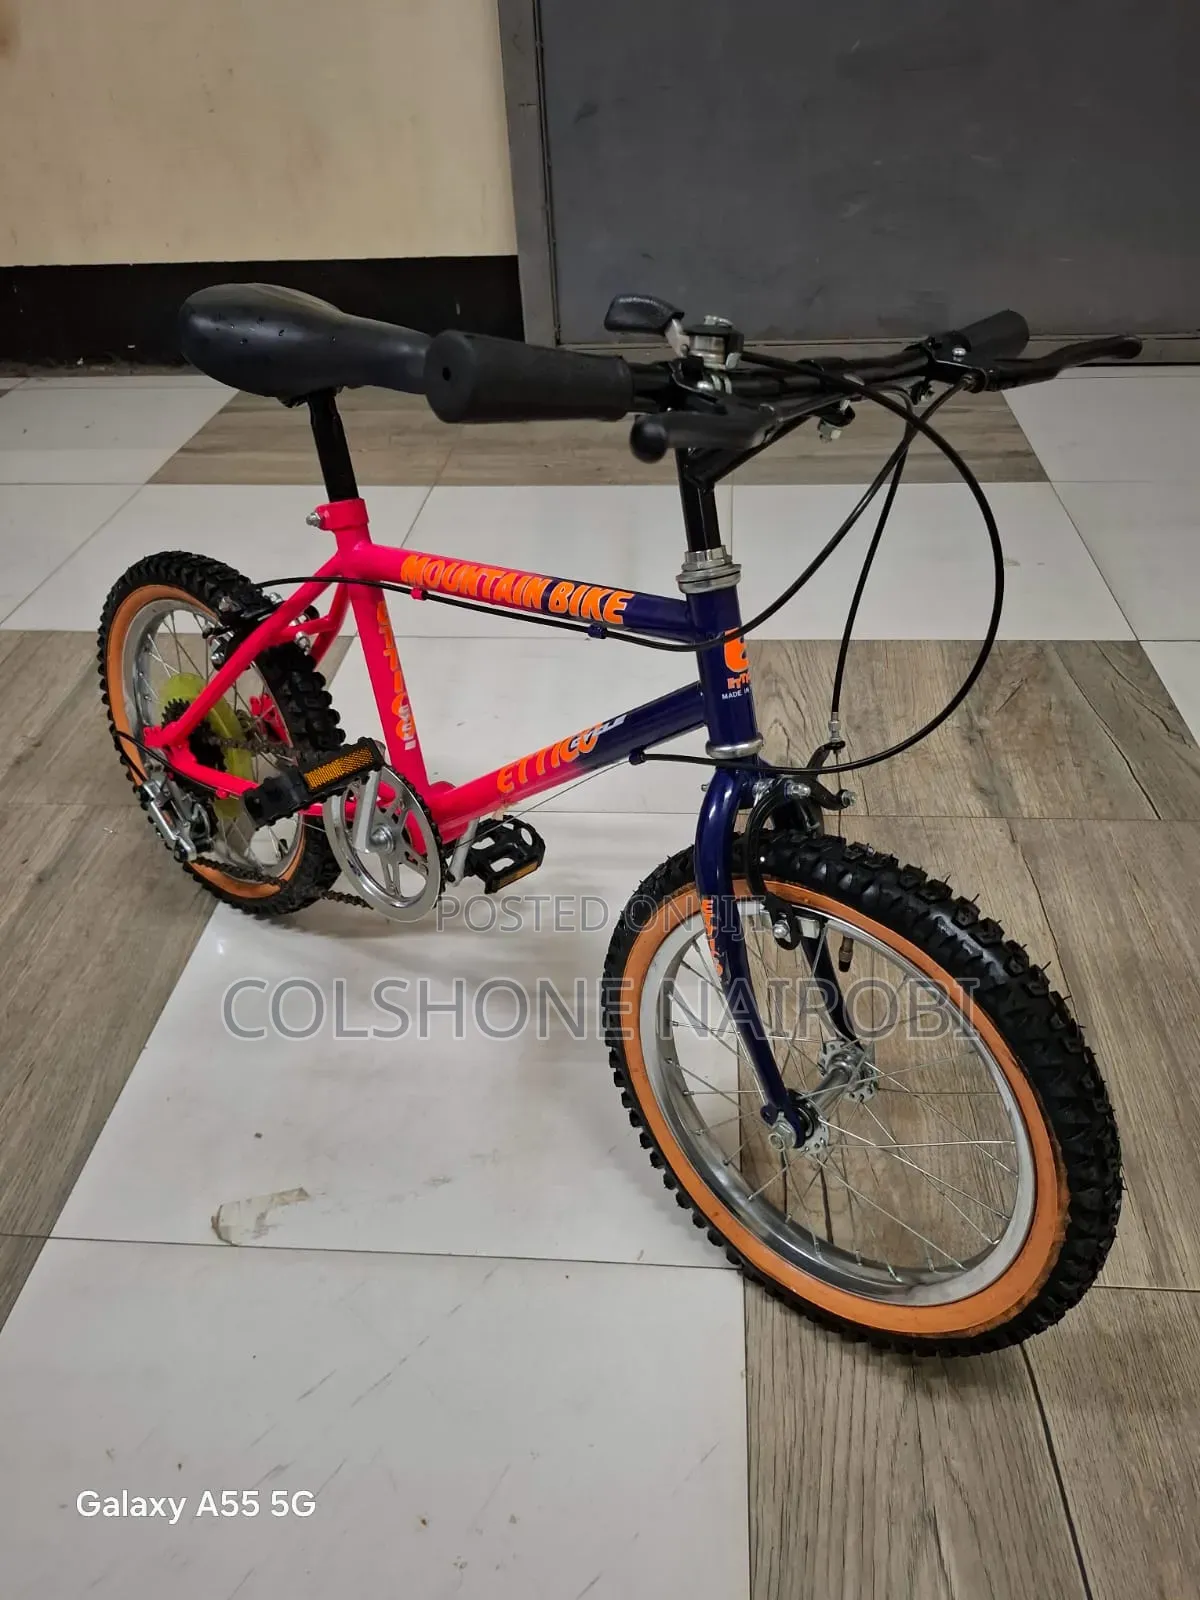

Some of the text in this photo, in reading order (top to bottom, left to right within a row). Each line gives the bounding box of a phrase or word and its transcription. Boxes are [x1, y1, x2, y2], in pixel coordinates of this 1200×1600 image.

[400, 554, 635, 625] MOUNTAIN BIKE
[721, 689, 743, 700] MADE
